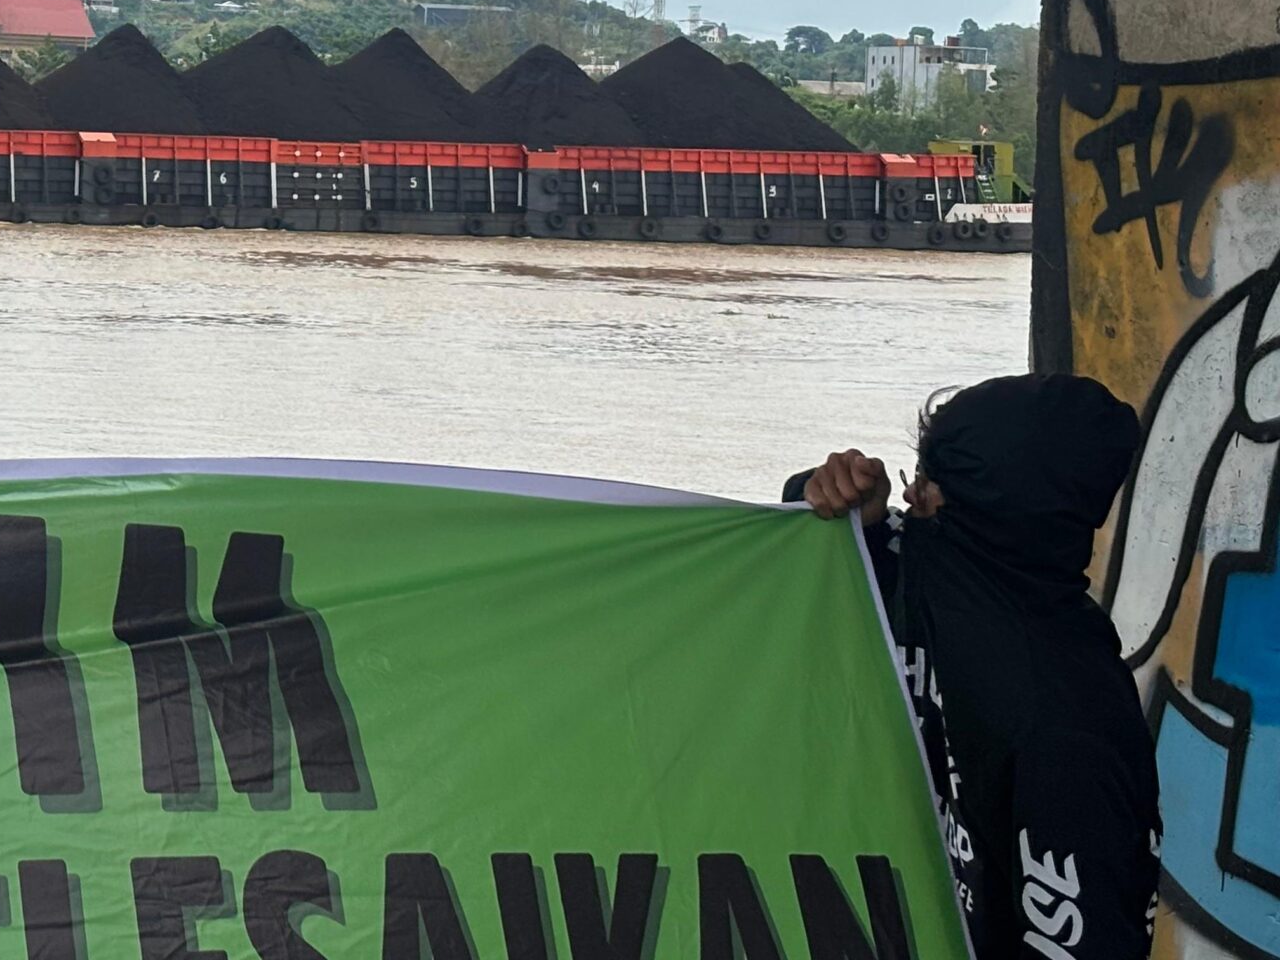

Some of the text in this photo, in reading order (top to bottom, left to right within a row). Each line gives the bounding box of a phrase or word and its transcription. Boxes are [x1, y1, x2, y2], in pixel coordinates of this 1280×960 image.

[152, 169, 161, 182] 7
[220, 171, 228, 184] 6
[409, 176, 418, 189] 5
